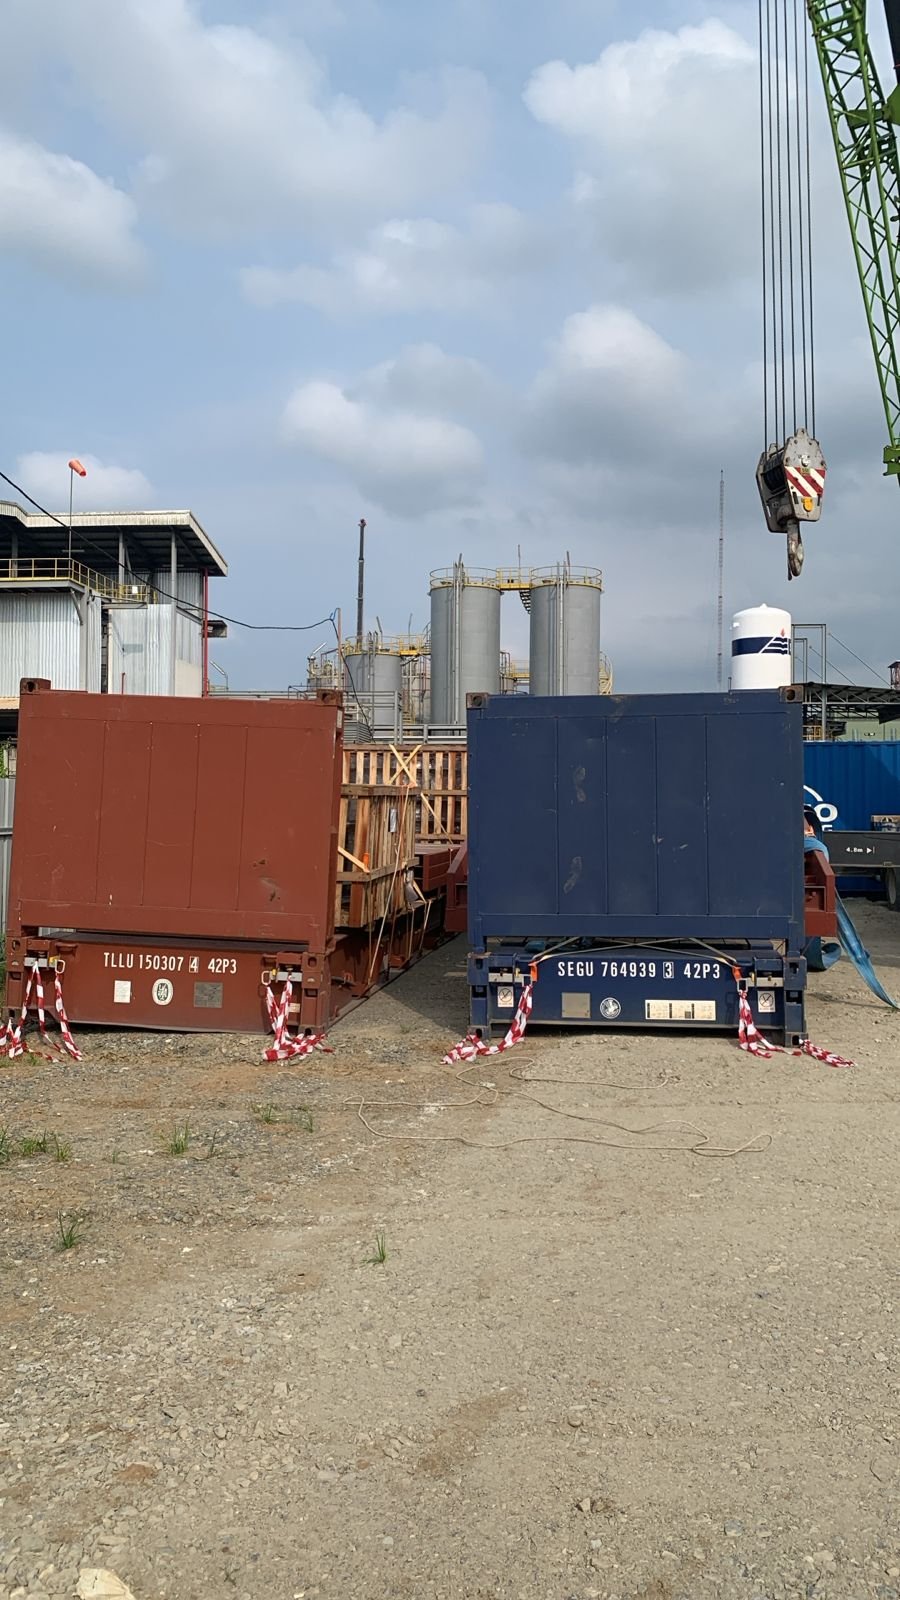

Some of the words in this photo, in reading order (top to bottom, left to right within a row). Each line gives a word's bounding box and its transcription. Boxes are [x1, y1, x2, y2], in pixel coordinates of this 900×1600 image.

[103, 952, 134, 968] TLLU
[139, 954, 184, 971] 150307
[189, 956, 199, 973] 4
[207, 957, 237, 974] 42P3
[557, 961, 594, 977] SEGU
[601, 962, 657, 978] 764939
[663, 962, 674, 979] 3
[683, 963, 721, 979] 42P3
